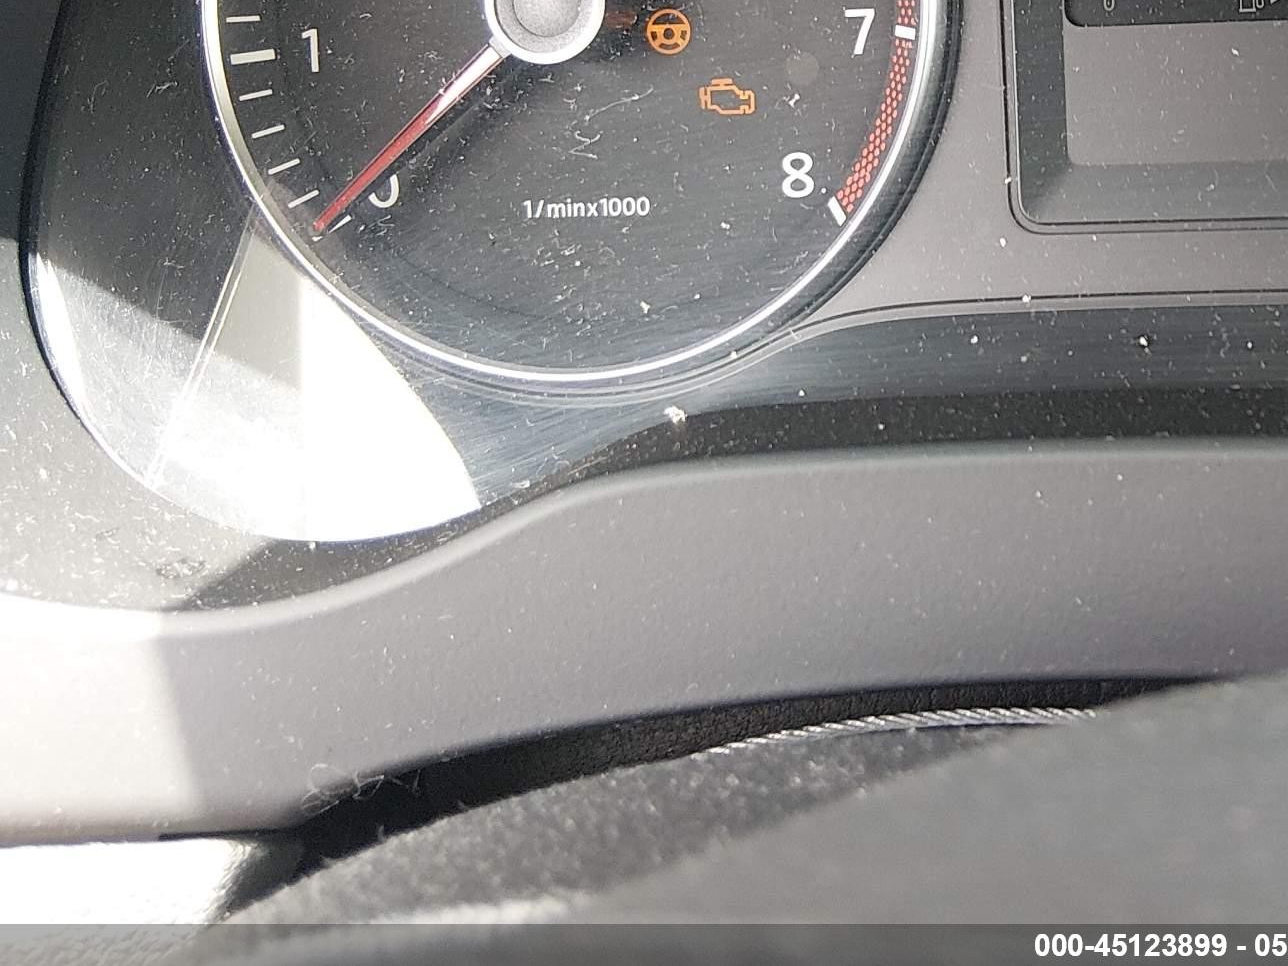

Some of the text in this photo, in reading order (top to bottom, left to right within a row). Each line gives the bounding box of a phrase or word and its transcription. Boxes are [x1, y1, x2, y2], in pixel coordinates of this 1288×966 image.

[300, 28, 320, 73] 1
[843, 8, 876, 55] 7
[781, 152, 815, 199] 8
[522, 195, 651, 219] 1/minx1000
